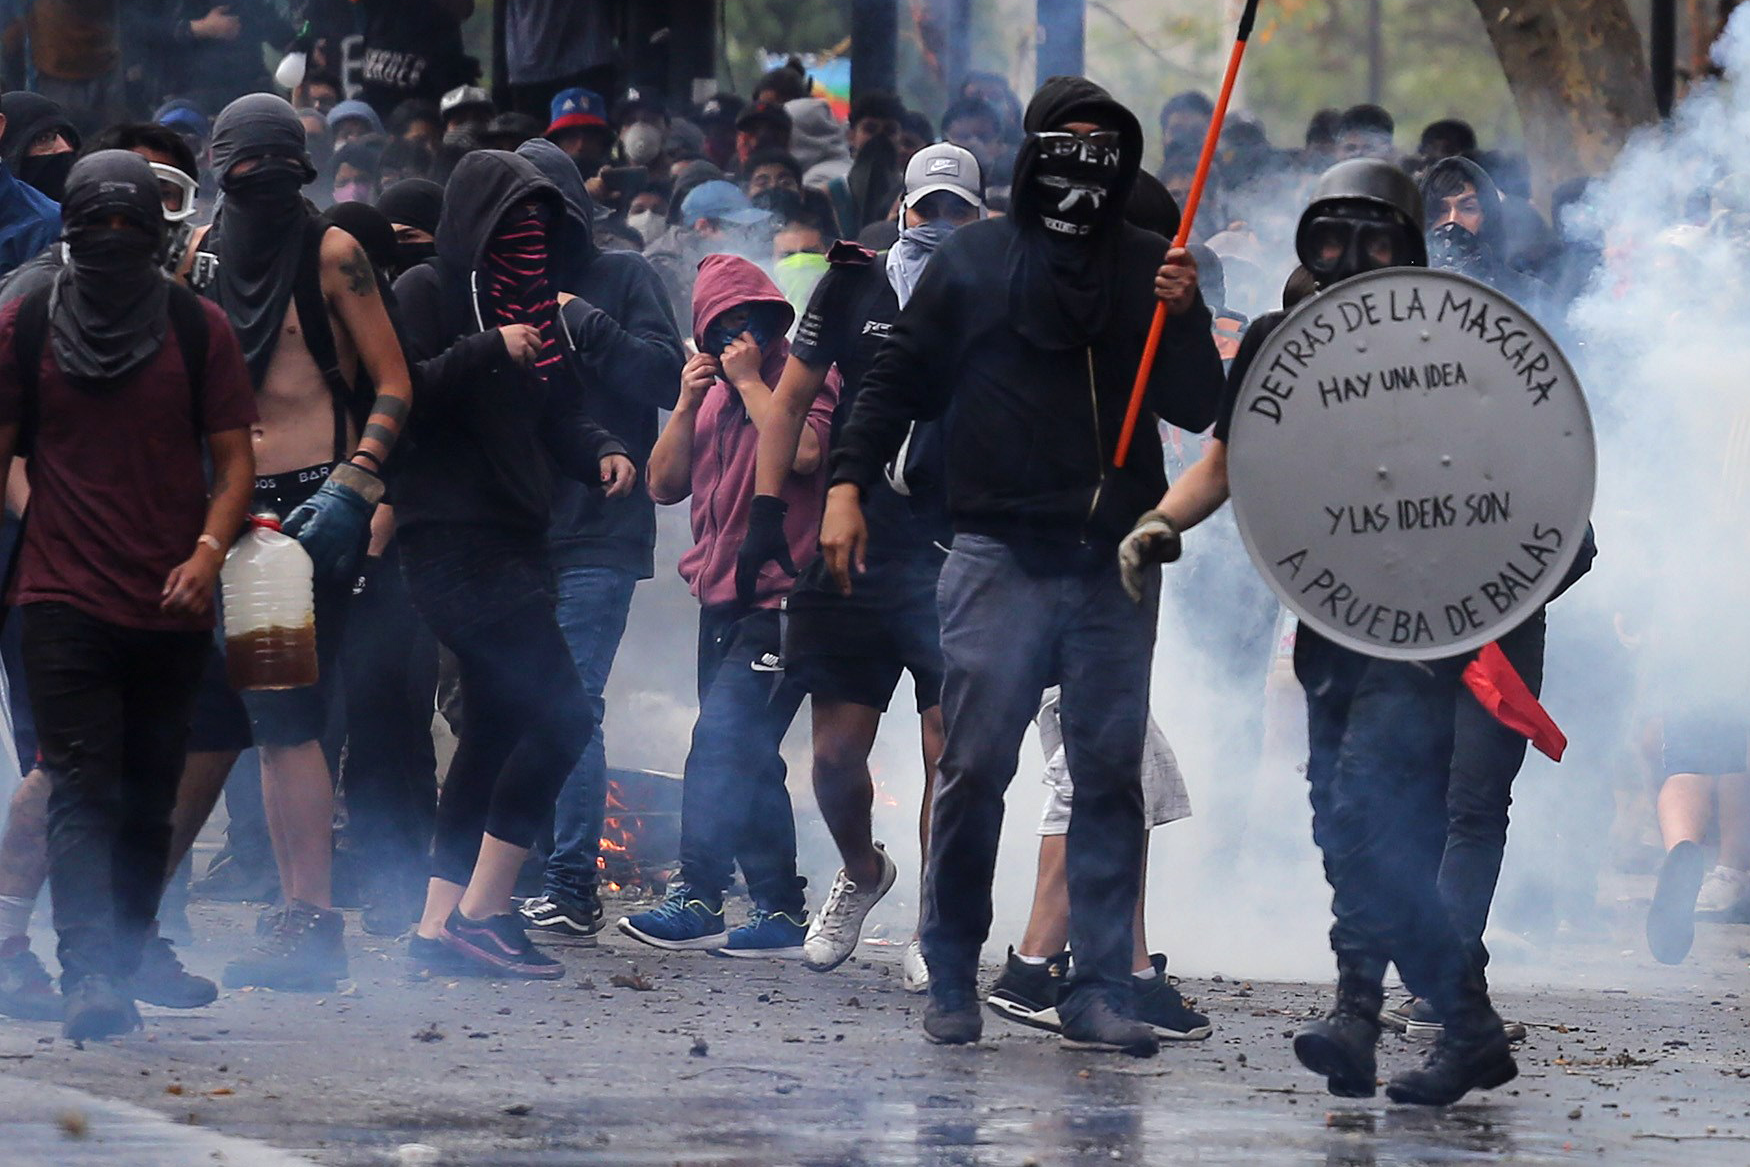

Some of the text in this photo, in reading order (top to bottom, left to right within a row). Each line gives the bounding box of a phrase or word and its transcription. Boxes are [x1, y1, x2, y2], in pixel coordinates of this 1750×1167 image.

[1249, 288, 1559, 423] DETRAS DE LA MASCARA
[1318, 362, 1468, 409] HAY UNA IDEA
[1398, 495, 1457, 531] IDEAS
[1465, 491, 1511, 524] SON
[1277, 523, 1563, 644] A PRUEBA DE BALAS
